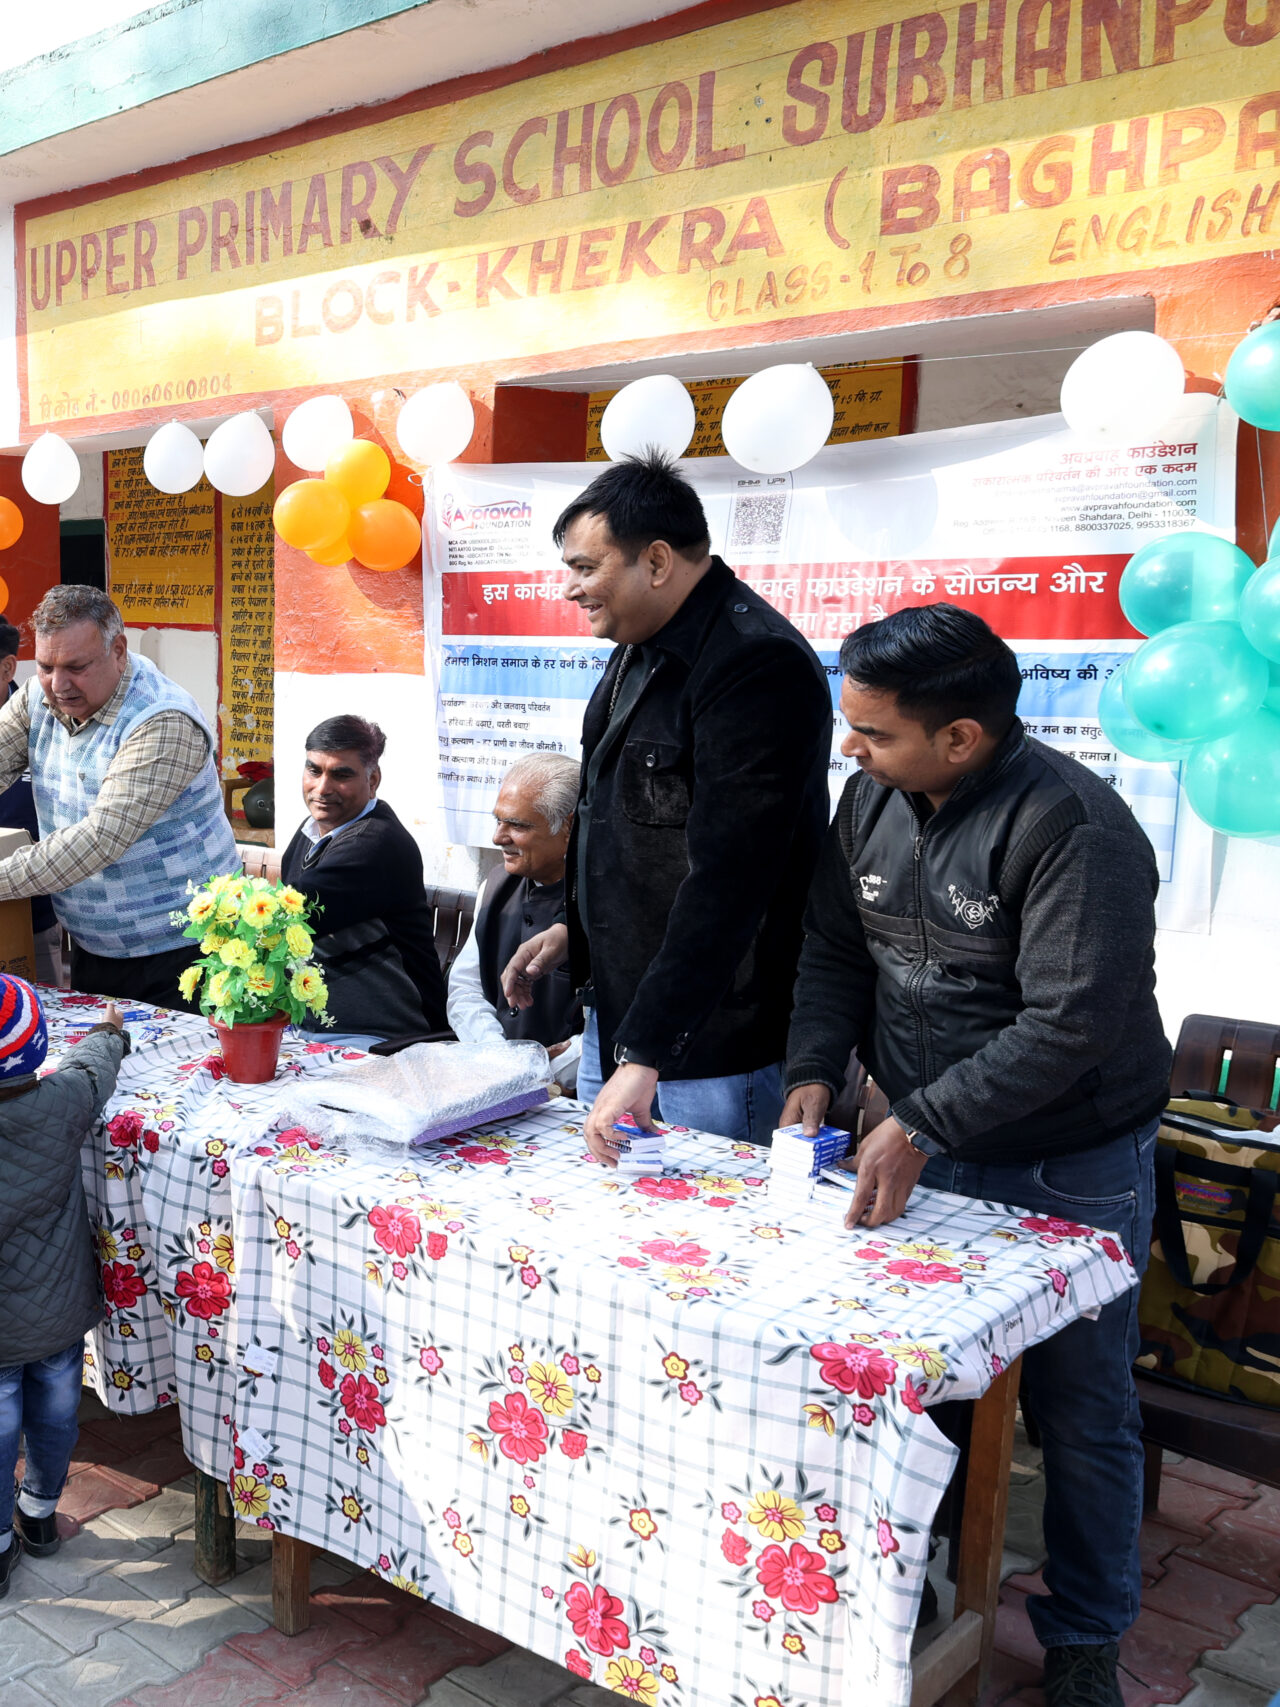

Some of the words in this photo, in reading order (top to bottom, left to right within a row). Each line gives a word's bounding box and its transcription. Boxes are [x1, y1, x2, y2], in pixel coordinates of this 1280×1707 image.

[29, 217, 158, 312] UPPER
[177, 143, 437, 281] PRIMARY
[453, 71, 746, 219] SCHOOL
[943, 232, 973, 282] 8
[1049, 181, 1280, 267] ENGLISH
[1127, 439, 1199, 460] फाउंडेशन
[1135, 464, 1158, 477] एक
[1161, 461, 1199, 475] कदम
[1075, 521, 1134, 532] 8800337025,
[1136, 519, 1196, 529] 9953318367
[1079, 512, 1125, 523] Shahdara,
[1128, 510, 1152, 520] Delhi
[1161, 508, 1197, 518] 110032
[482, 584, 508, 605] इस
[805, 570, 905, 599] फाउंडेशन
[912, 567, 936, 596] के
[942, 565, 1041, 597] सौजन्य
[1049, 562, 1108, 594] और
[825, 611, 863, 634] रहा
[472, 653, 498, 668] मिशन
[500, 657, 529, 669] समाज
[531, 655, 541, 669] के
[543, 659, 556, 670] हर
[559, 655, 575, 670] वर्ग
[578, 656, 588, 670] के
[1021, 663, 1071, 681] भविष्य
[1076, 663, 1099, 681] की
[1042, 724, 1059, 736] मन
[1063, 725, 1078, 737] का
